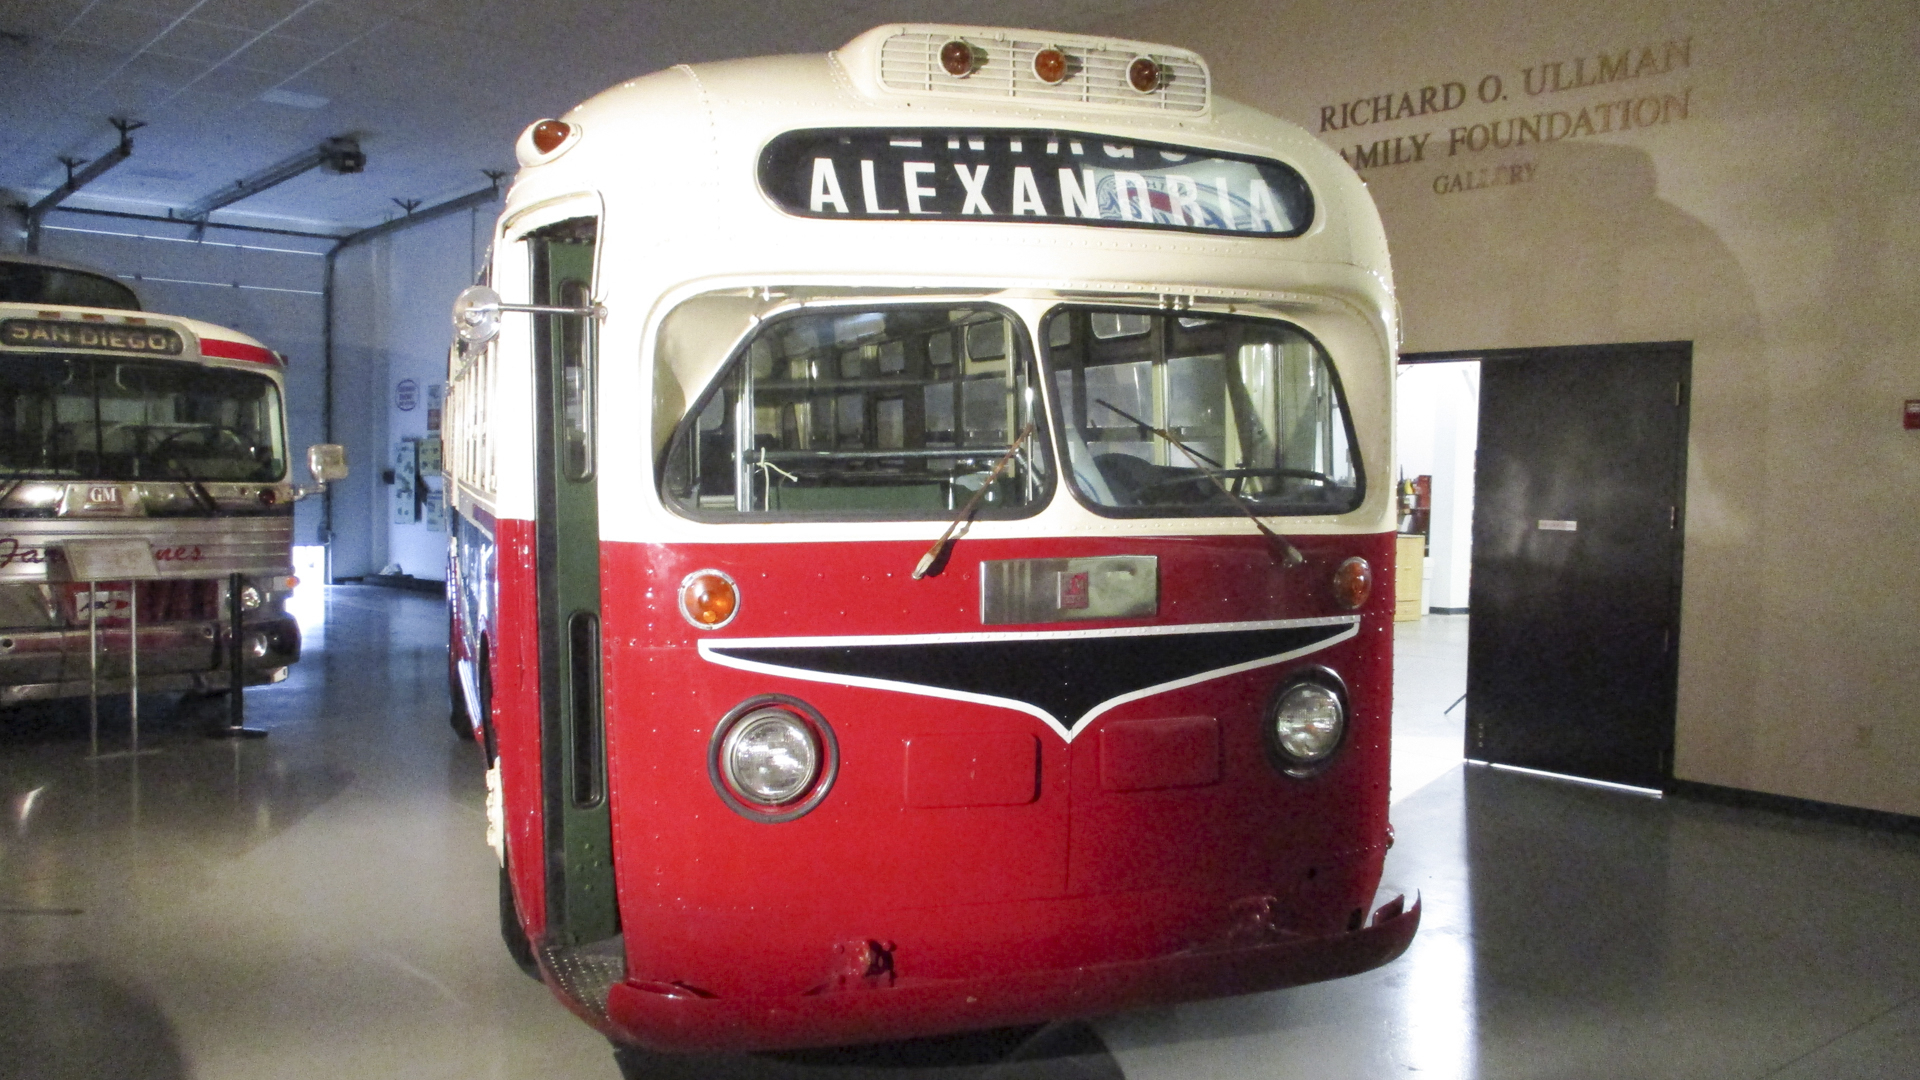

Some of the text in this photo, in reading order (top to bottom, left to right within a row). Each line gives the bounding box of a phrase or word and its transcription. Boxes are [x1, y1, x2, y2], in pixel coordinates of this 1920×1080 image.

[1319, 35, 1692, 133] RICHARD O. ULLMAN
[1448, 87, 1692, 157] FOUNDATION
[809, 157, 1295, 233] ALEXANDRIA
[1432, 163, 1536, 195] GALLERY
[11, 323, 167, 350] SAN DIEGO
[90, 487, 116, 503] GM
